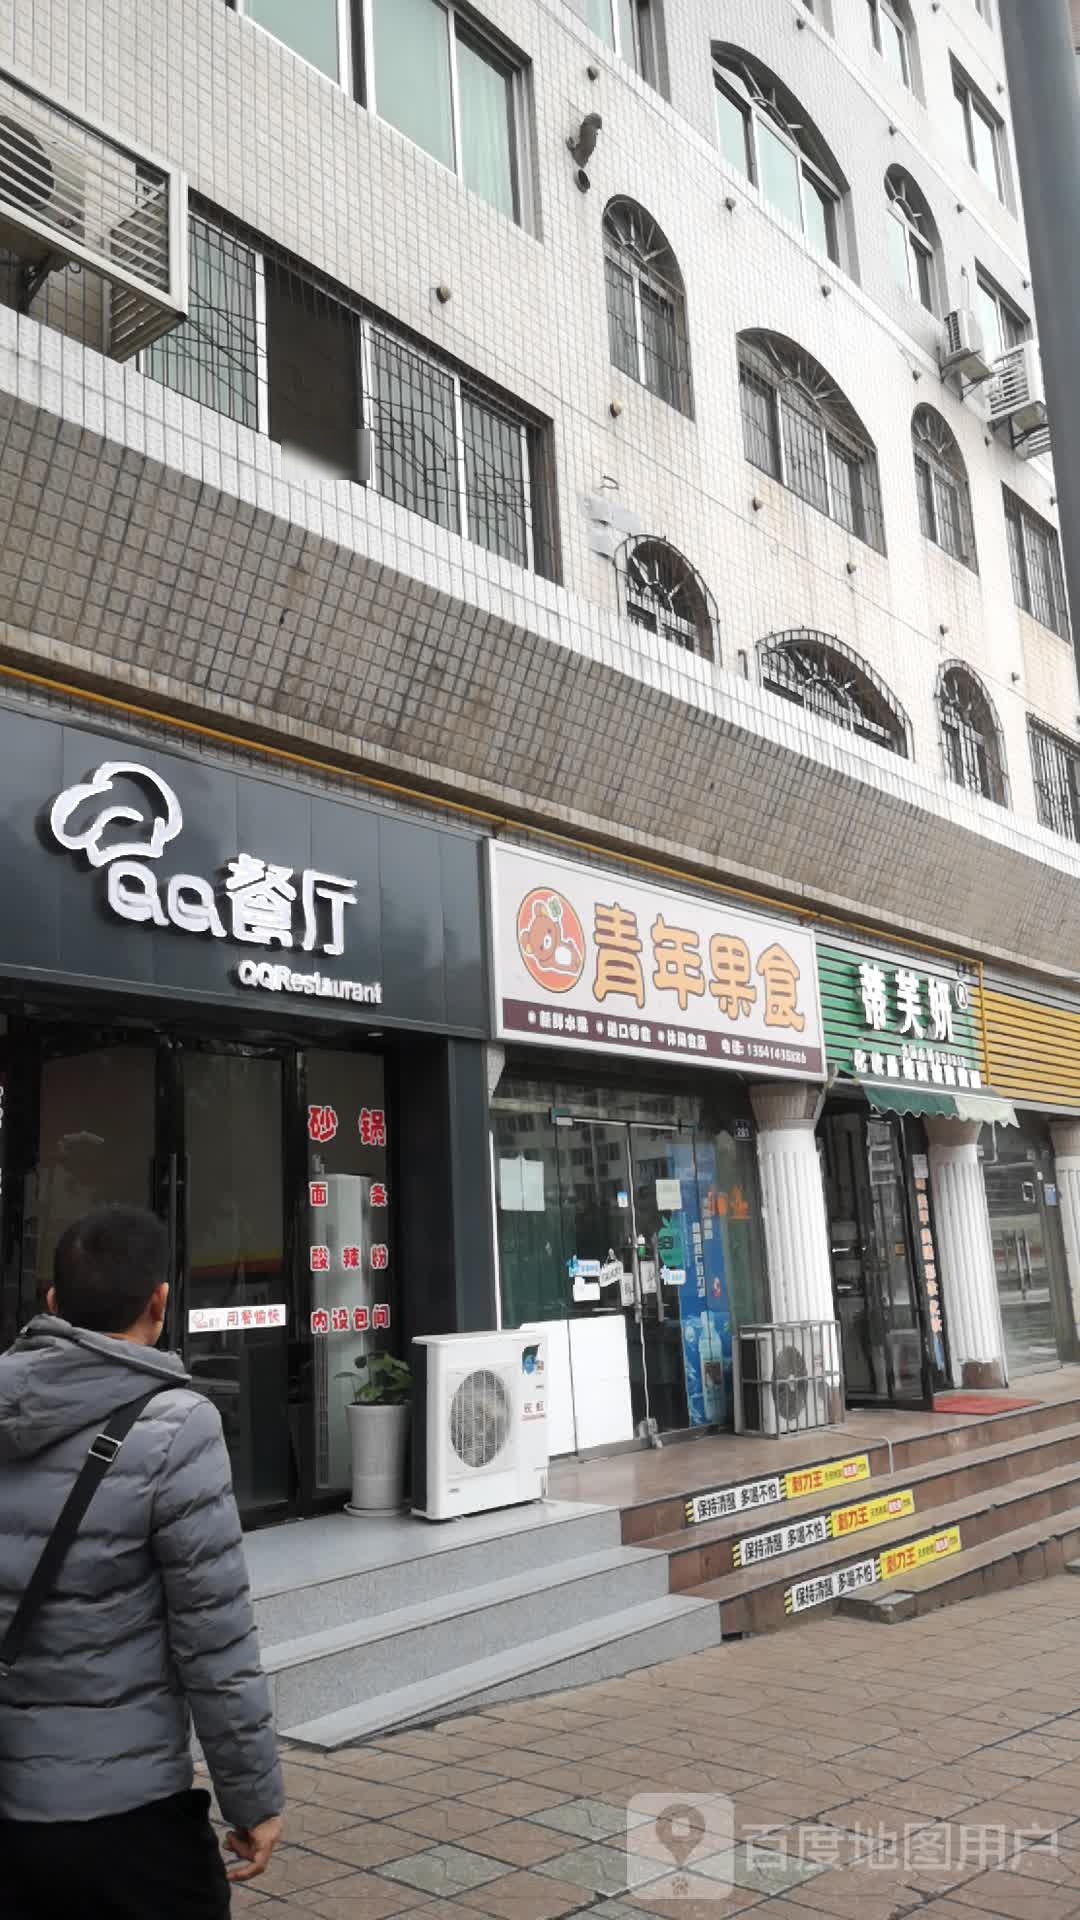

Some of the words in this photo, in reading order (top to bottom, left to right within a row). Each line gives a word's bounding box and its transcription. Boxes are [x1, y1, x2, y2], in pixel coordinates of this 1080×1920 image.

[593, 901, 805, 1032] 青年果食
[307, 1105, 386, 1147] 砂锅
[309, 1181, 387, 1207] 面条
[310, 1244, 387, 1272] 酸辣粉
[311, 1305, 390, 1334] 内设包间
[697, 1491, 736, 1520] 保持清醒
[745, 1534, 783, 1560] 保持清醒
[796, 1577, 834, 1606] 保持清醒
